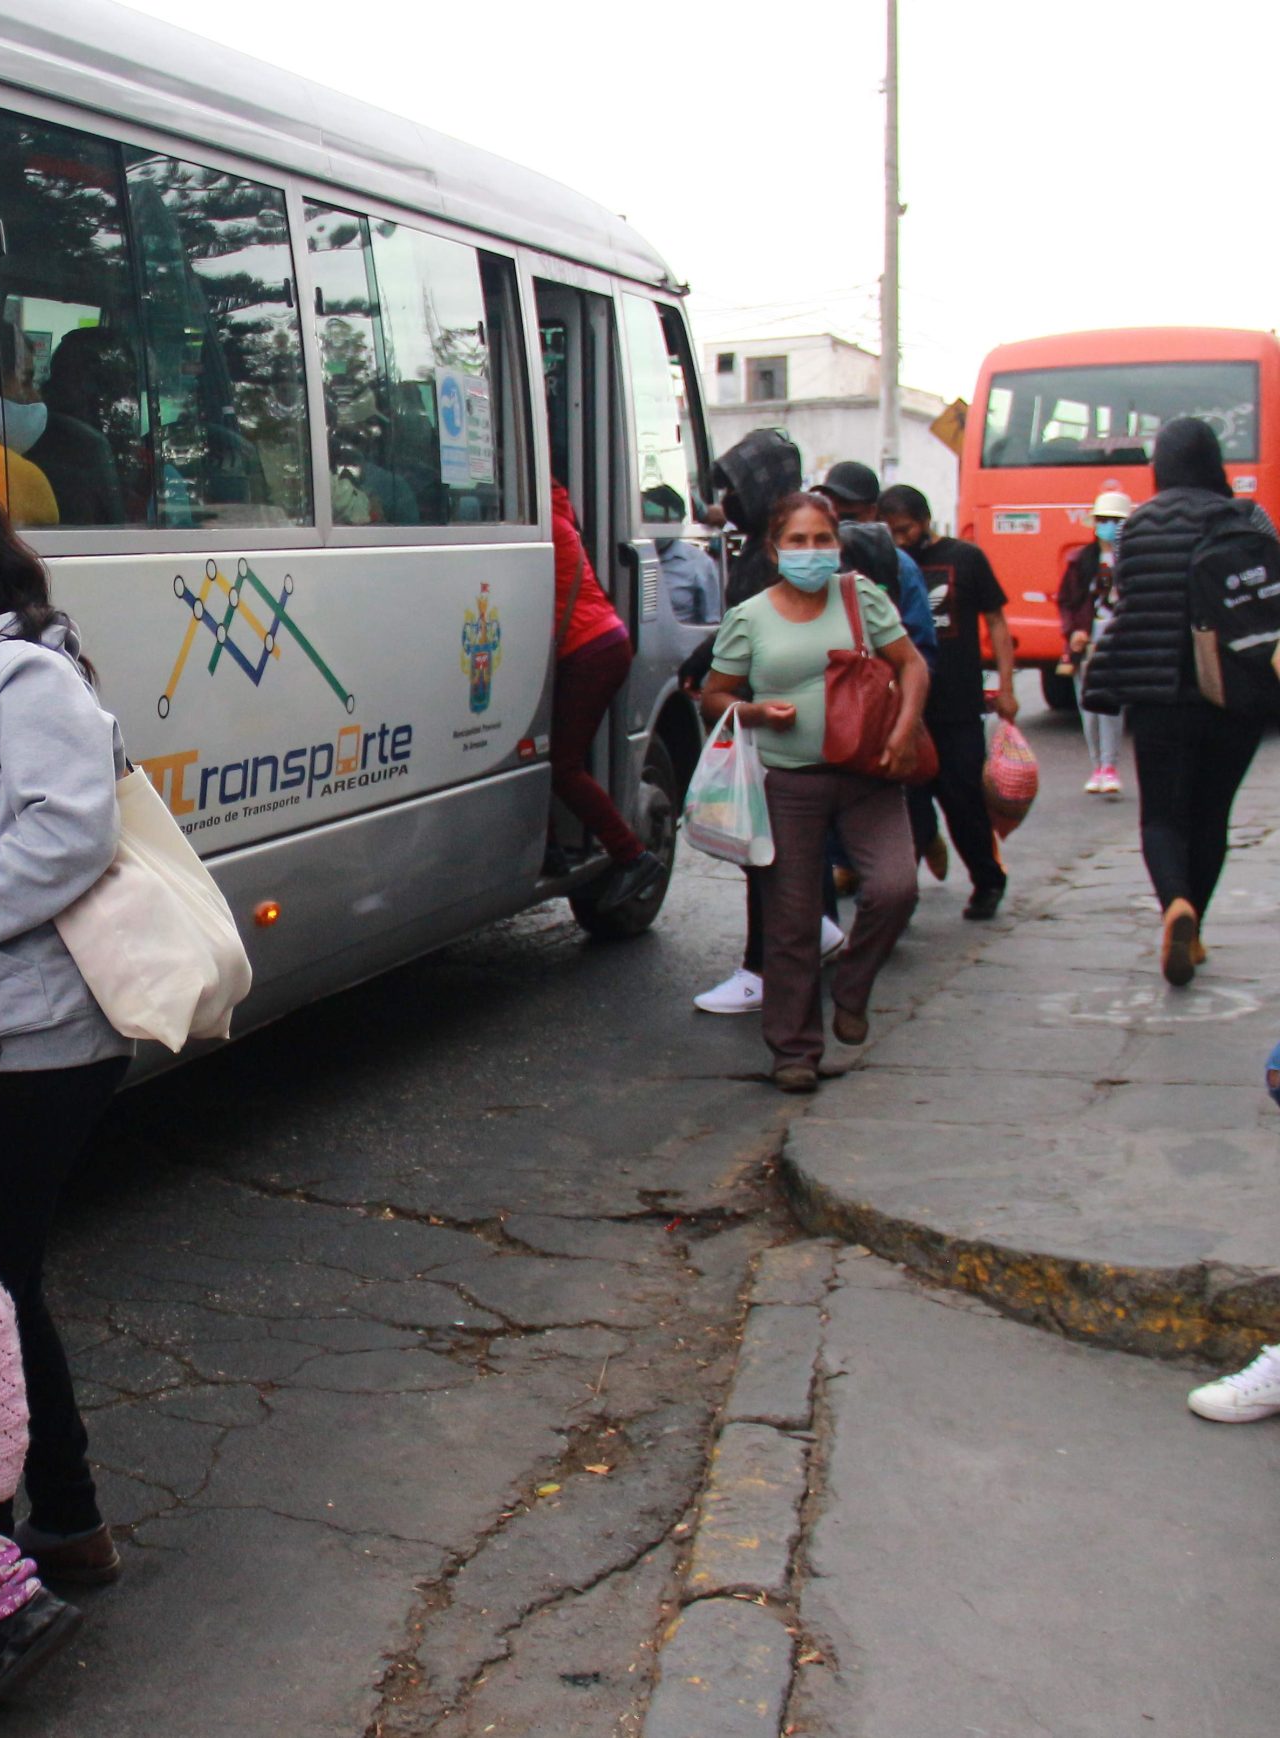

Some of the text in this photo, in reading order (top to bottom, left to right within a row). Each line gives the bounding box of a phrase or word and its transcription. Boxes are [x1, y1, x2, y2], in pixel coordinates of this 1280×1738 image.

[320, 764, 409, 797] AREQUIPA
[179, 794, 301, 837] egrado de Transporte
